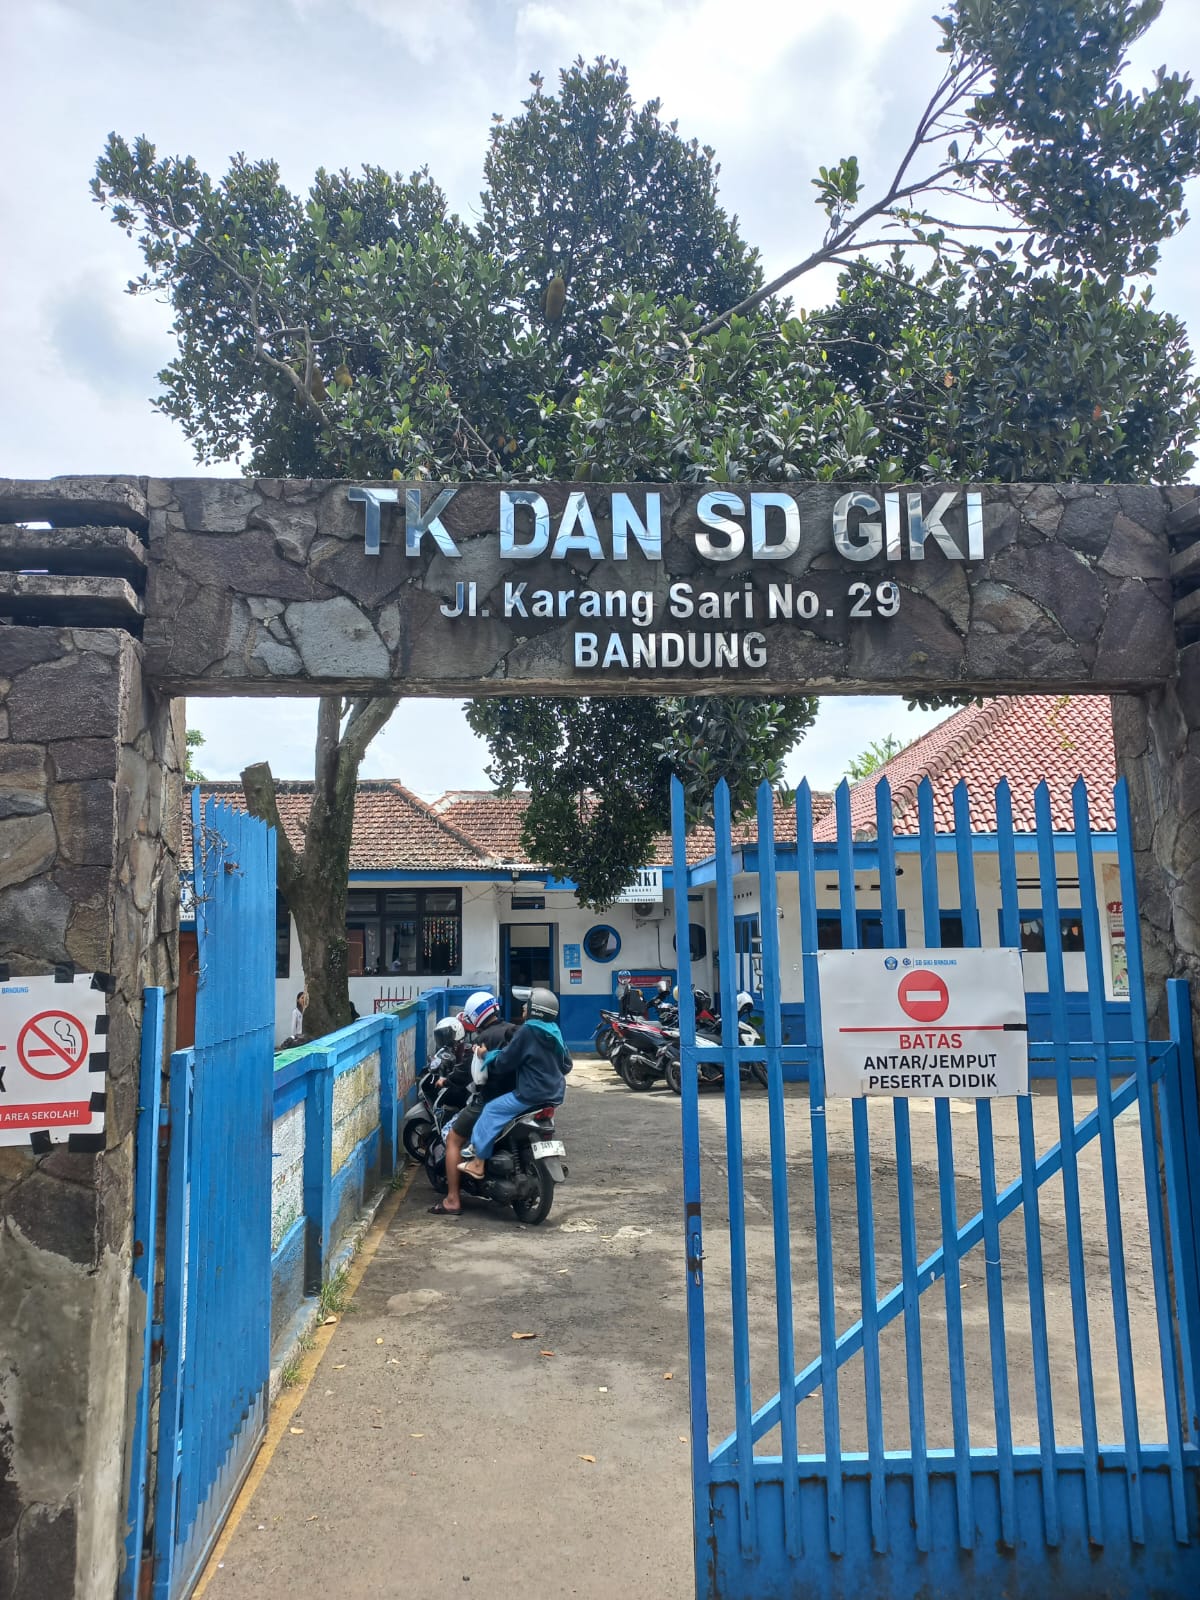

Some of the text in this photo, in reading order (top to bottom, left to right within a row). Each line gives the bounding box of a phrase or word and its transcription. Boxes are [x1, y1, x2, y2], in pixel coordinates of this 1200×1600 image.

[348, 487, 985, 561] TK DAN SD GIKI
[503, 581, 654, 626] Karang
[669, 582, 753, 619] Sari
[768, 582, 834, 619] No.
[847, 581, 901, 618] 29
[574, 631, 768, 668] BANDUNG
[899, 1033, 963, 1050] BATAS
[863, 1053, 997, 1071] ANTAR/JEMPUT
[869, 1073, 998, 1089] PESERTA DIDIK
[4, 1112, 30, 1122] AREA
[31, 1109, 79, 1120] SEKOLAH!
